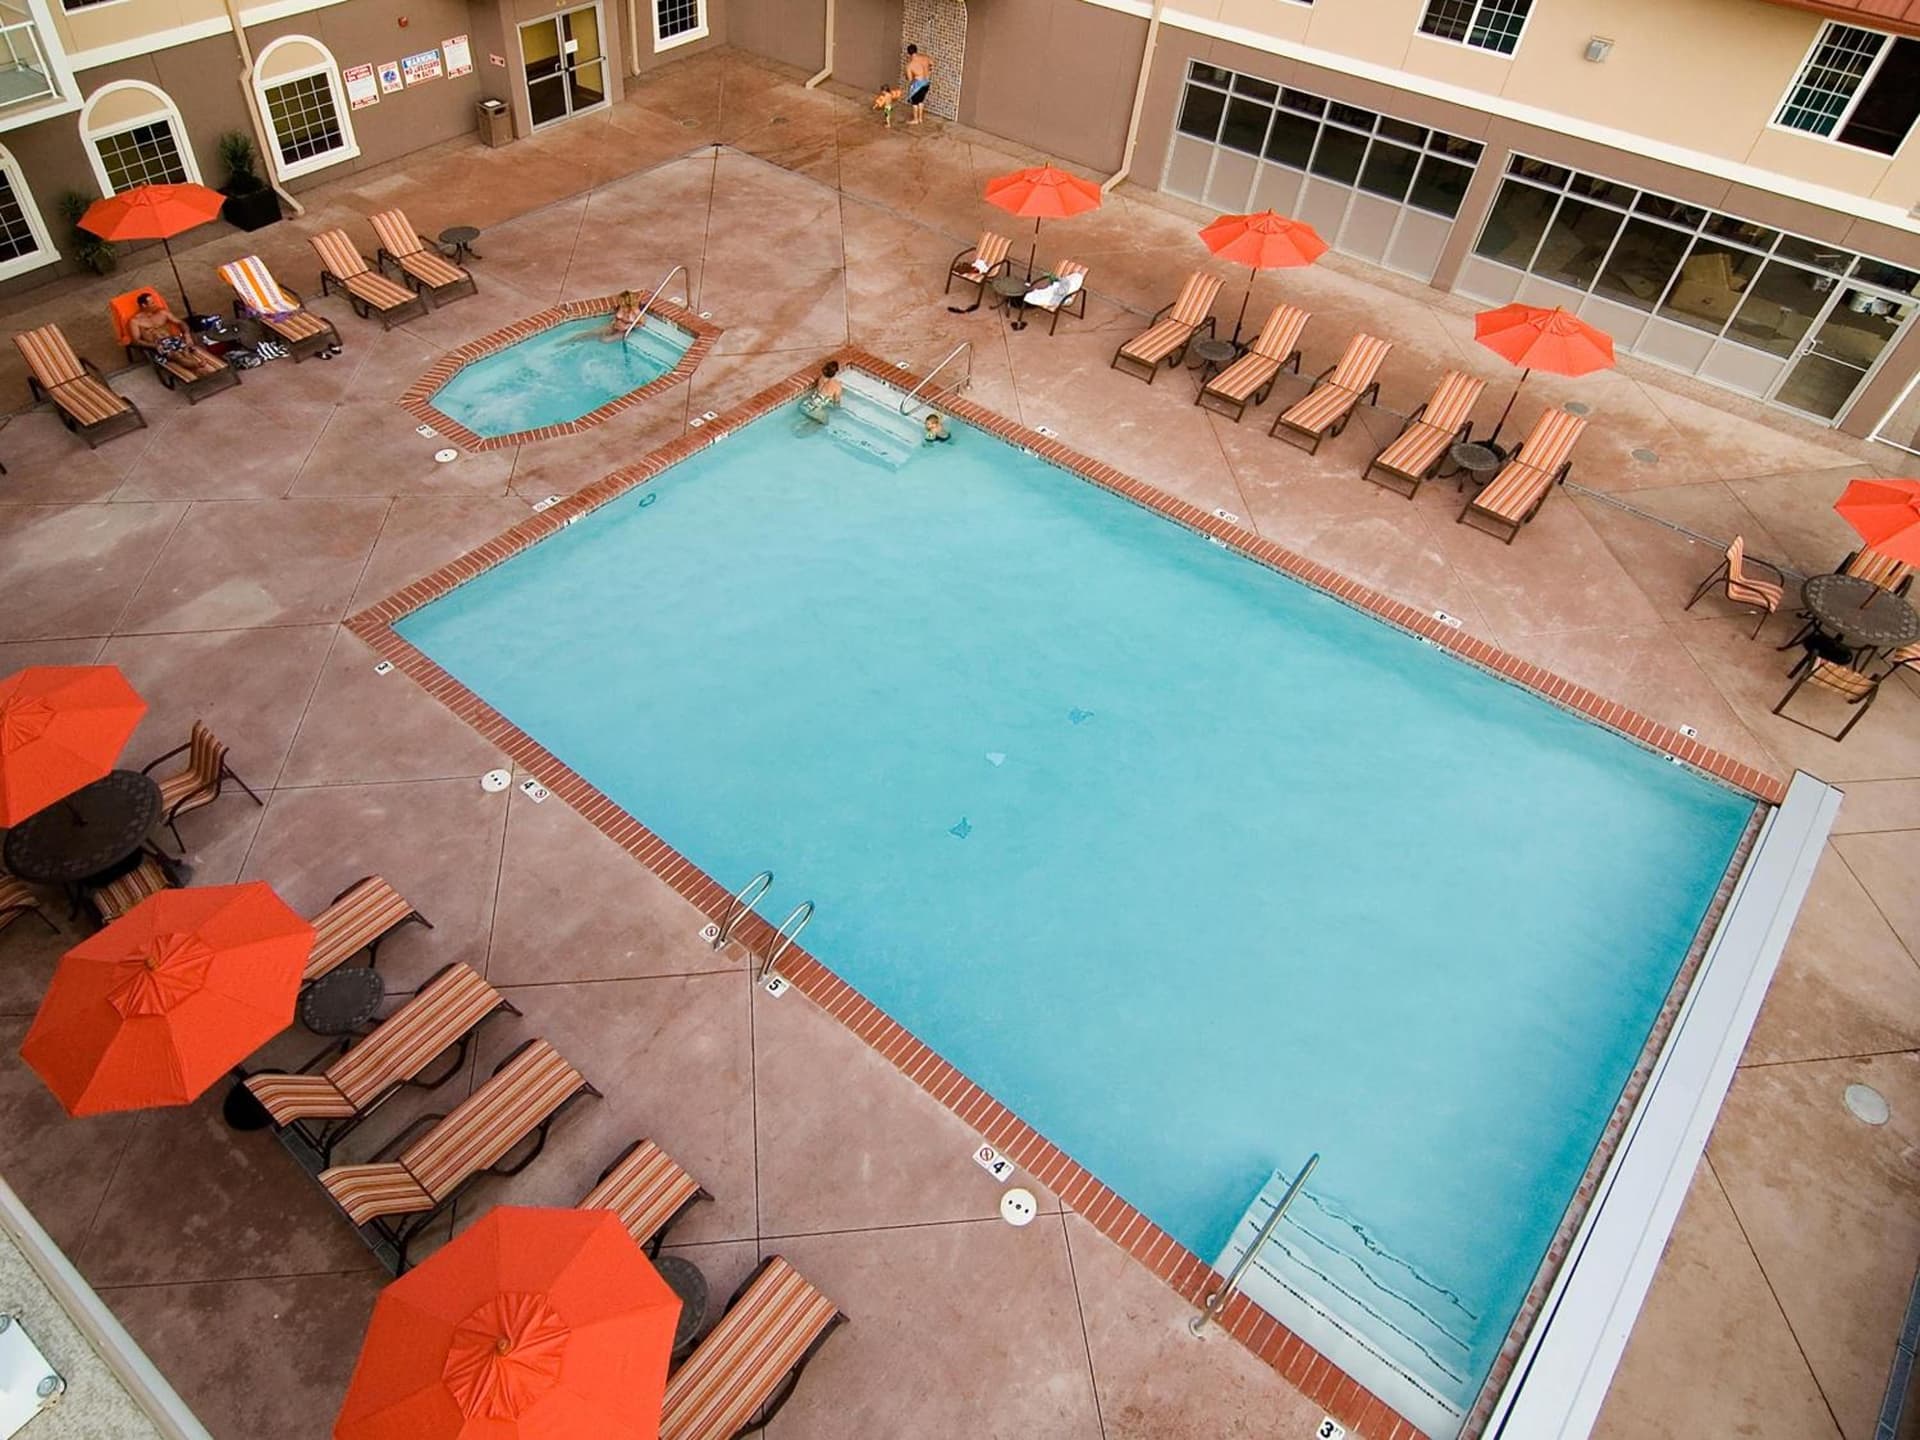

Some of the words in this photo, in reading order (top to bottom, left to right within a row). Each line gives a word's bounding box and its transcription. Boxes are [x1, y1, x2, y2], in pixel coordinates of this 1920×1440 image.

[377, 662, 389, 671] 3
[524, 781, 535, 790] 4
[769, 979, 782, 991] 5
[993, 1161, 1006, 1174] 4
[1319, 1421, 1335, 1439] 3
